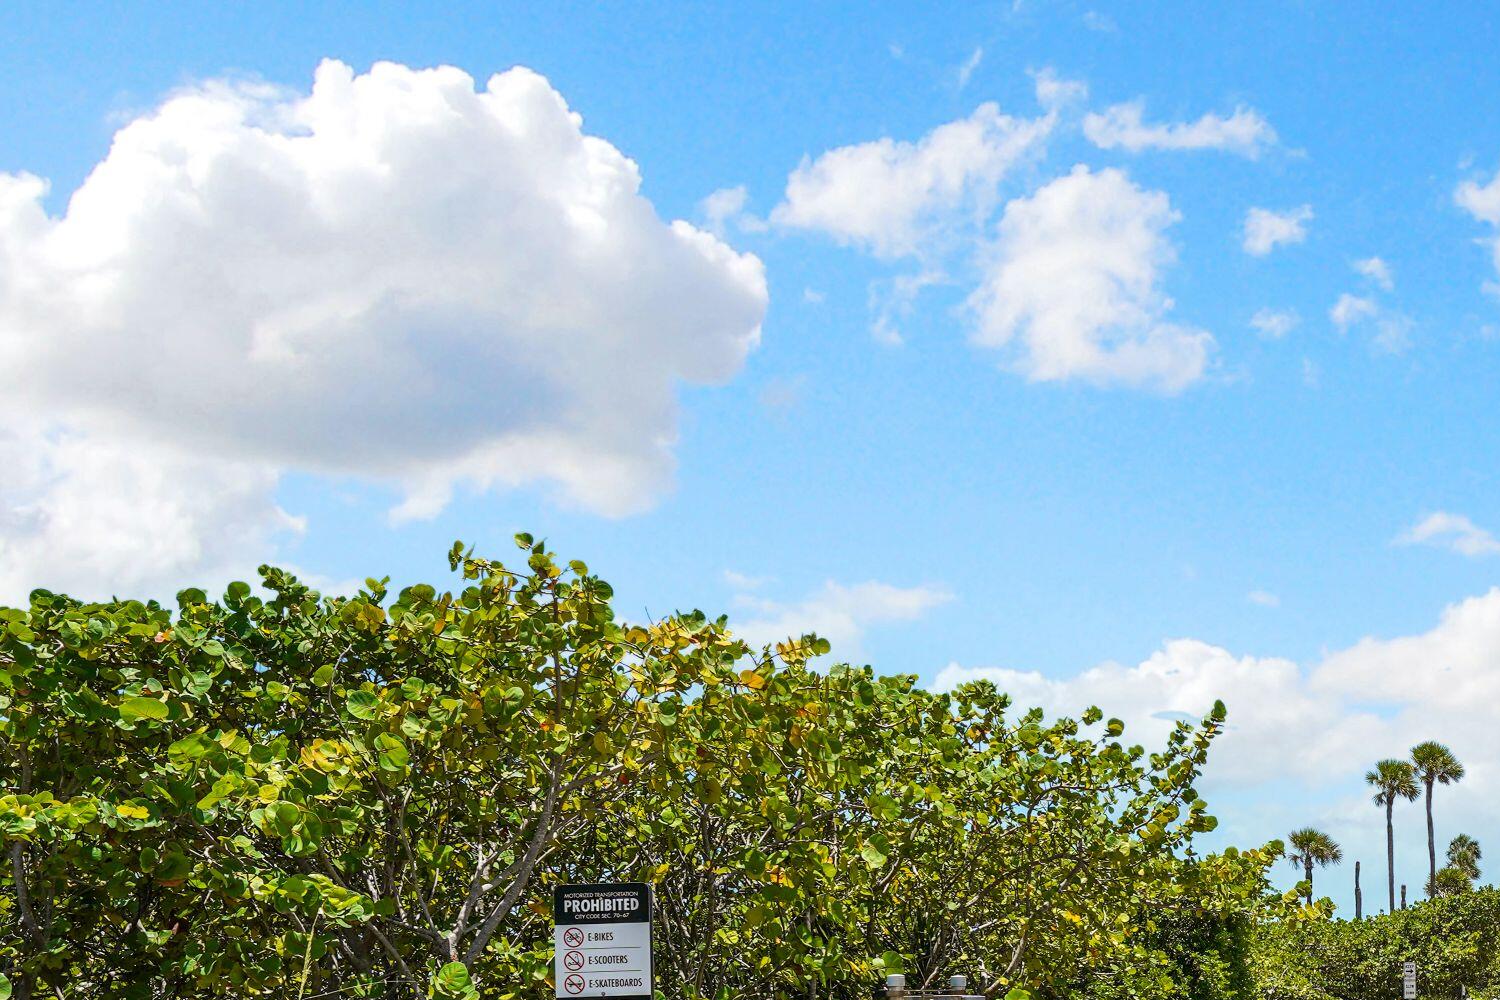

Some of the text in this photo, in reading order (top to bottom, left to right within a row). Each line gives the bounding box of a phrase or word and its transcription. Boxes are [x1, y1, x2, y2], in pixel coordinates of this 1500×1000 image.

[564, 898, 639, 912] PROHIBITED
[588, 932, 614, 941] E-BIKES
[588, 954, 628, 965] E-SCOOTERS
[589, 978, 643, 988] E-SKATEBOARDS
